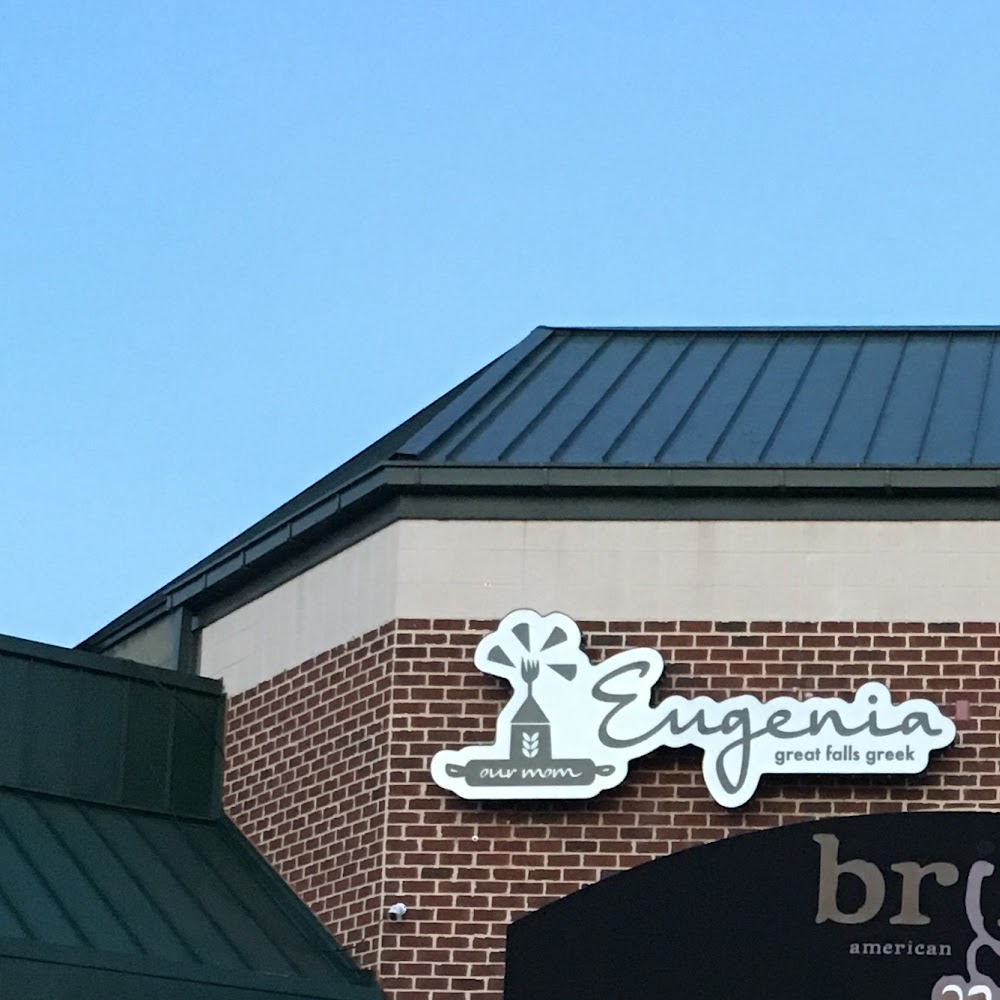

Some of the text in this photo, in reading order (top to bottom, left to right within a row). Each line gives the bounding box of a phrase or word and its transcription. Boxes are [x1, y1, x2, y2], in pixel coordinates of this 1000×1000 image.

[591, 660, 943, 794] Eugenia
[774, 745, 915, 766] great falls greek
[479, 765, 583, 780] our mom
[849, 941, 952, 956] american
